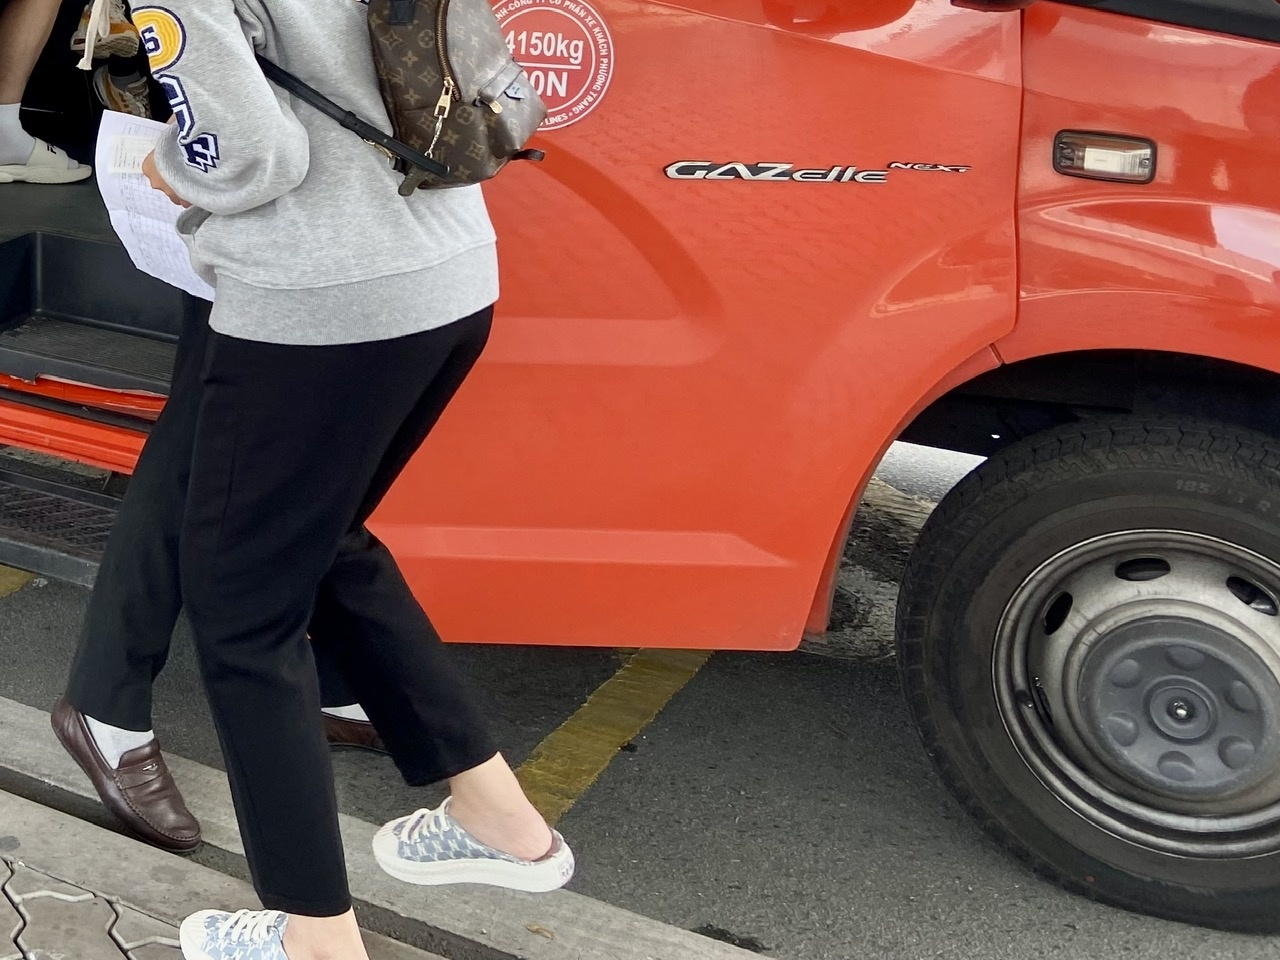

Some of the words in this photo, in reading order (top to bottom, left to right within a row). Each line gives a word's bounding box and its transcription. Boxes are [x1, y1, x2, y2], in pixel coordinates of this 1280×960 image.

[584, 15, 597, 28] XE
[505, 30, 584, 64] 4150kg
[592, 27, 608, 56] KHÁCH
[592, 57, 609, 93] PHƯƠNG
[573, 90, 598, 114] TRANG
[545, 113, 568, 126] LINES
